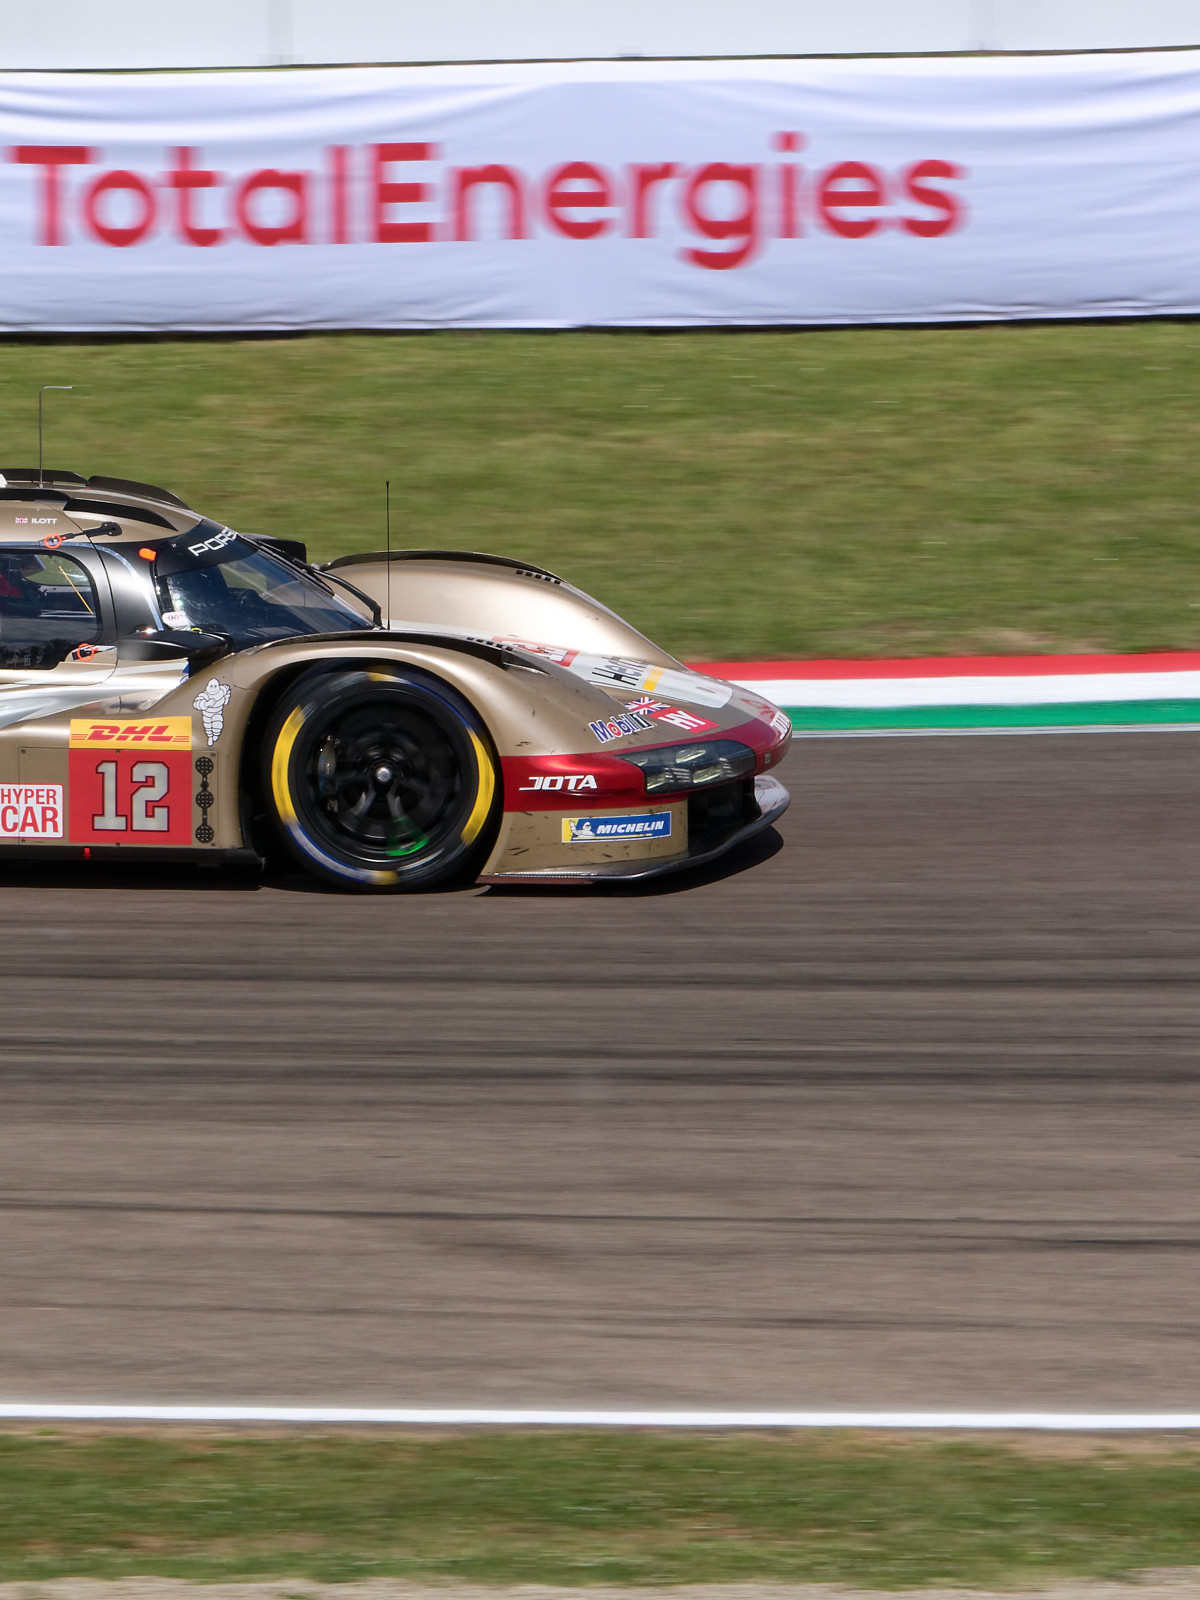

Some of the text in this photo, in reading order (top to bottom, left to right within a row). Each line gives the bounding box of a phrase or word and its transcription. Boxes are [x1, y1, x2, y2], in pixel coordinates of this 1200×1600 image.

[6, 130, 968, 270] TotalEnergies
[31, 517, 58, 525] ILOTT
[589, 713, 641, 743] Mobil
[657, 710, 706, 730] HY
[86, 725, 175, 742] DHL
[519, 774, 598, 791] JOTA
[0, 788, 57, 804] HYPER
[92, 760, 170, 832] 12
[0, 805, 59, 833] CAR
[596, 820, 665, 835] MICHELIN
